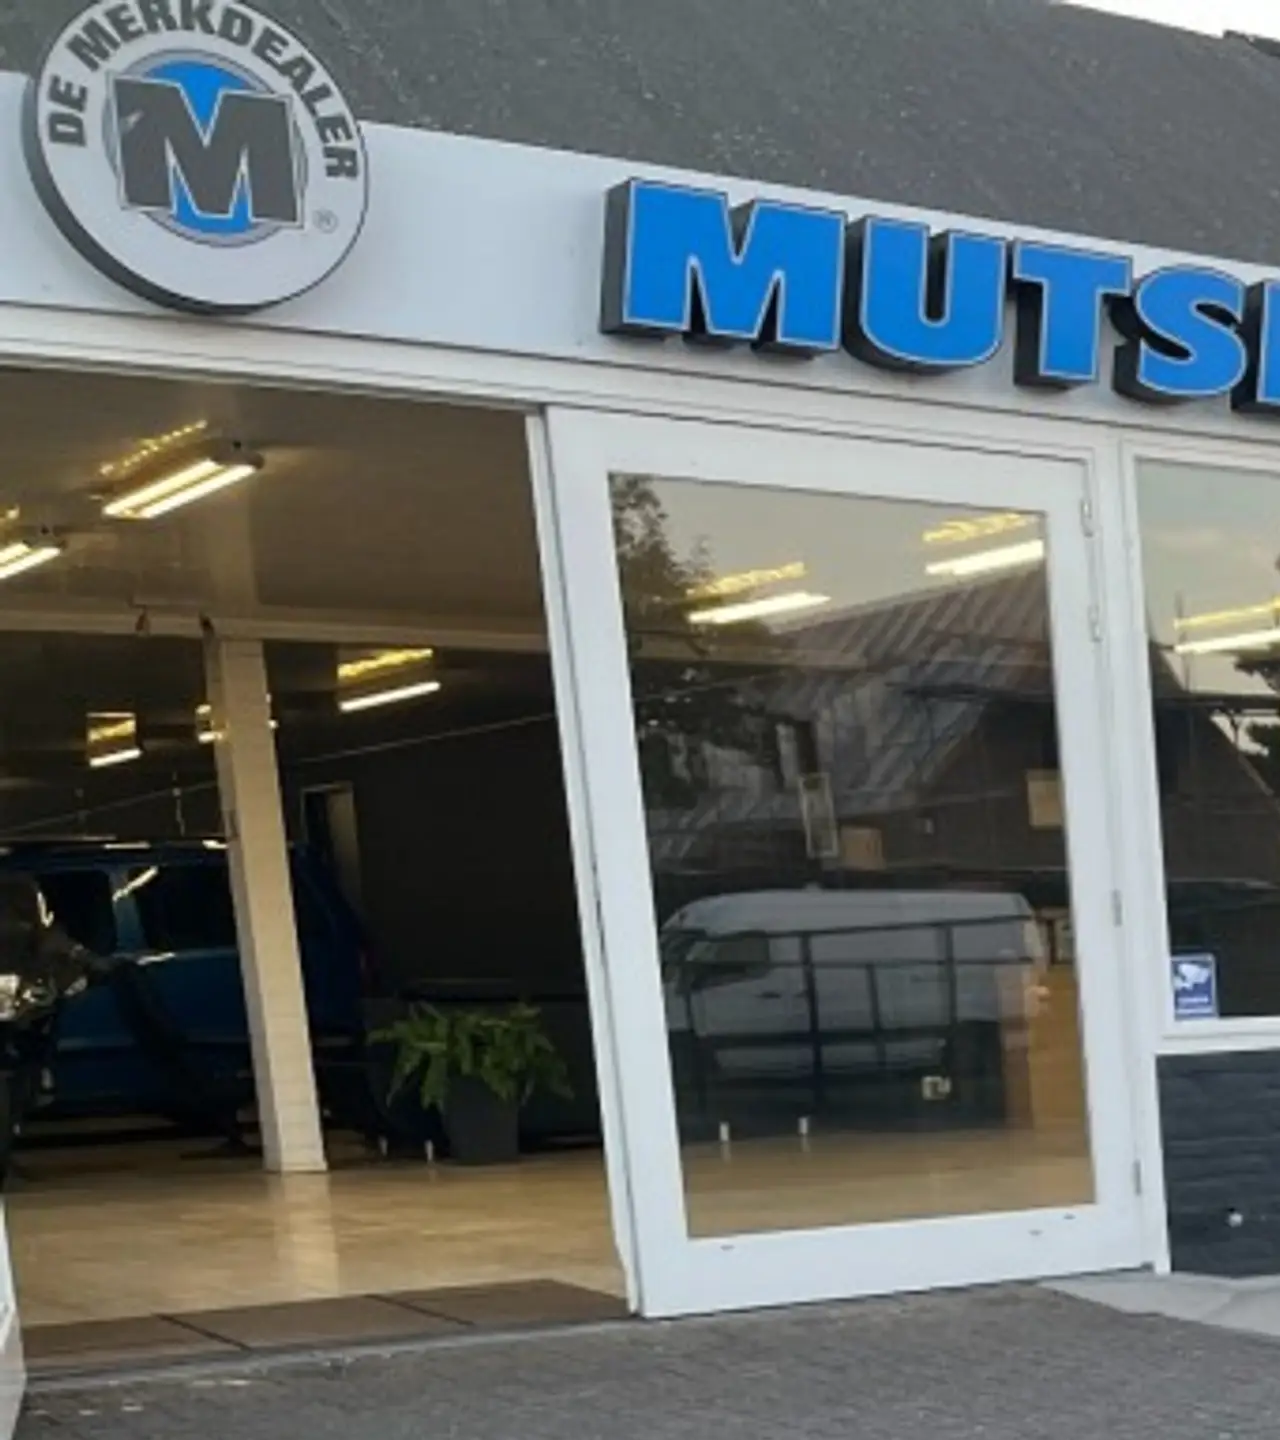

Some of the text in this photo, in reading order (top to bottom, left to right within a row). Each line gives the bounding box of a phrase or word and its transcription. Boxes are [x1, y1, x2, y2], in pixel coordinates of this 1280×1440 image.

[46, 0, 359, 180] DE MERKDEALER
[109, 74, 302, 227] M
